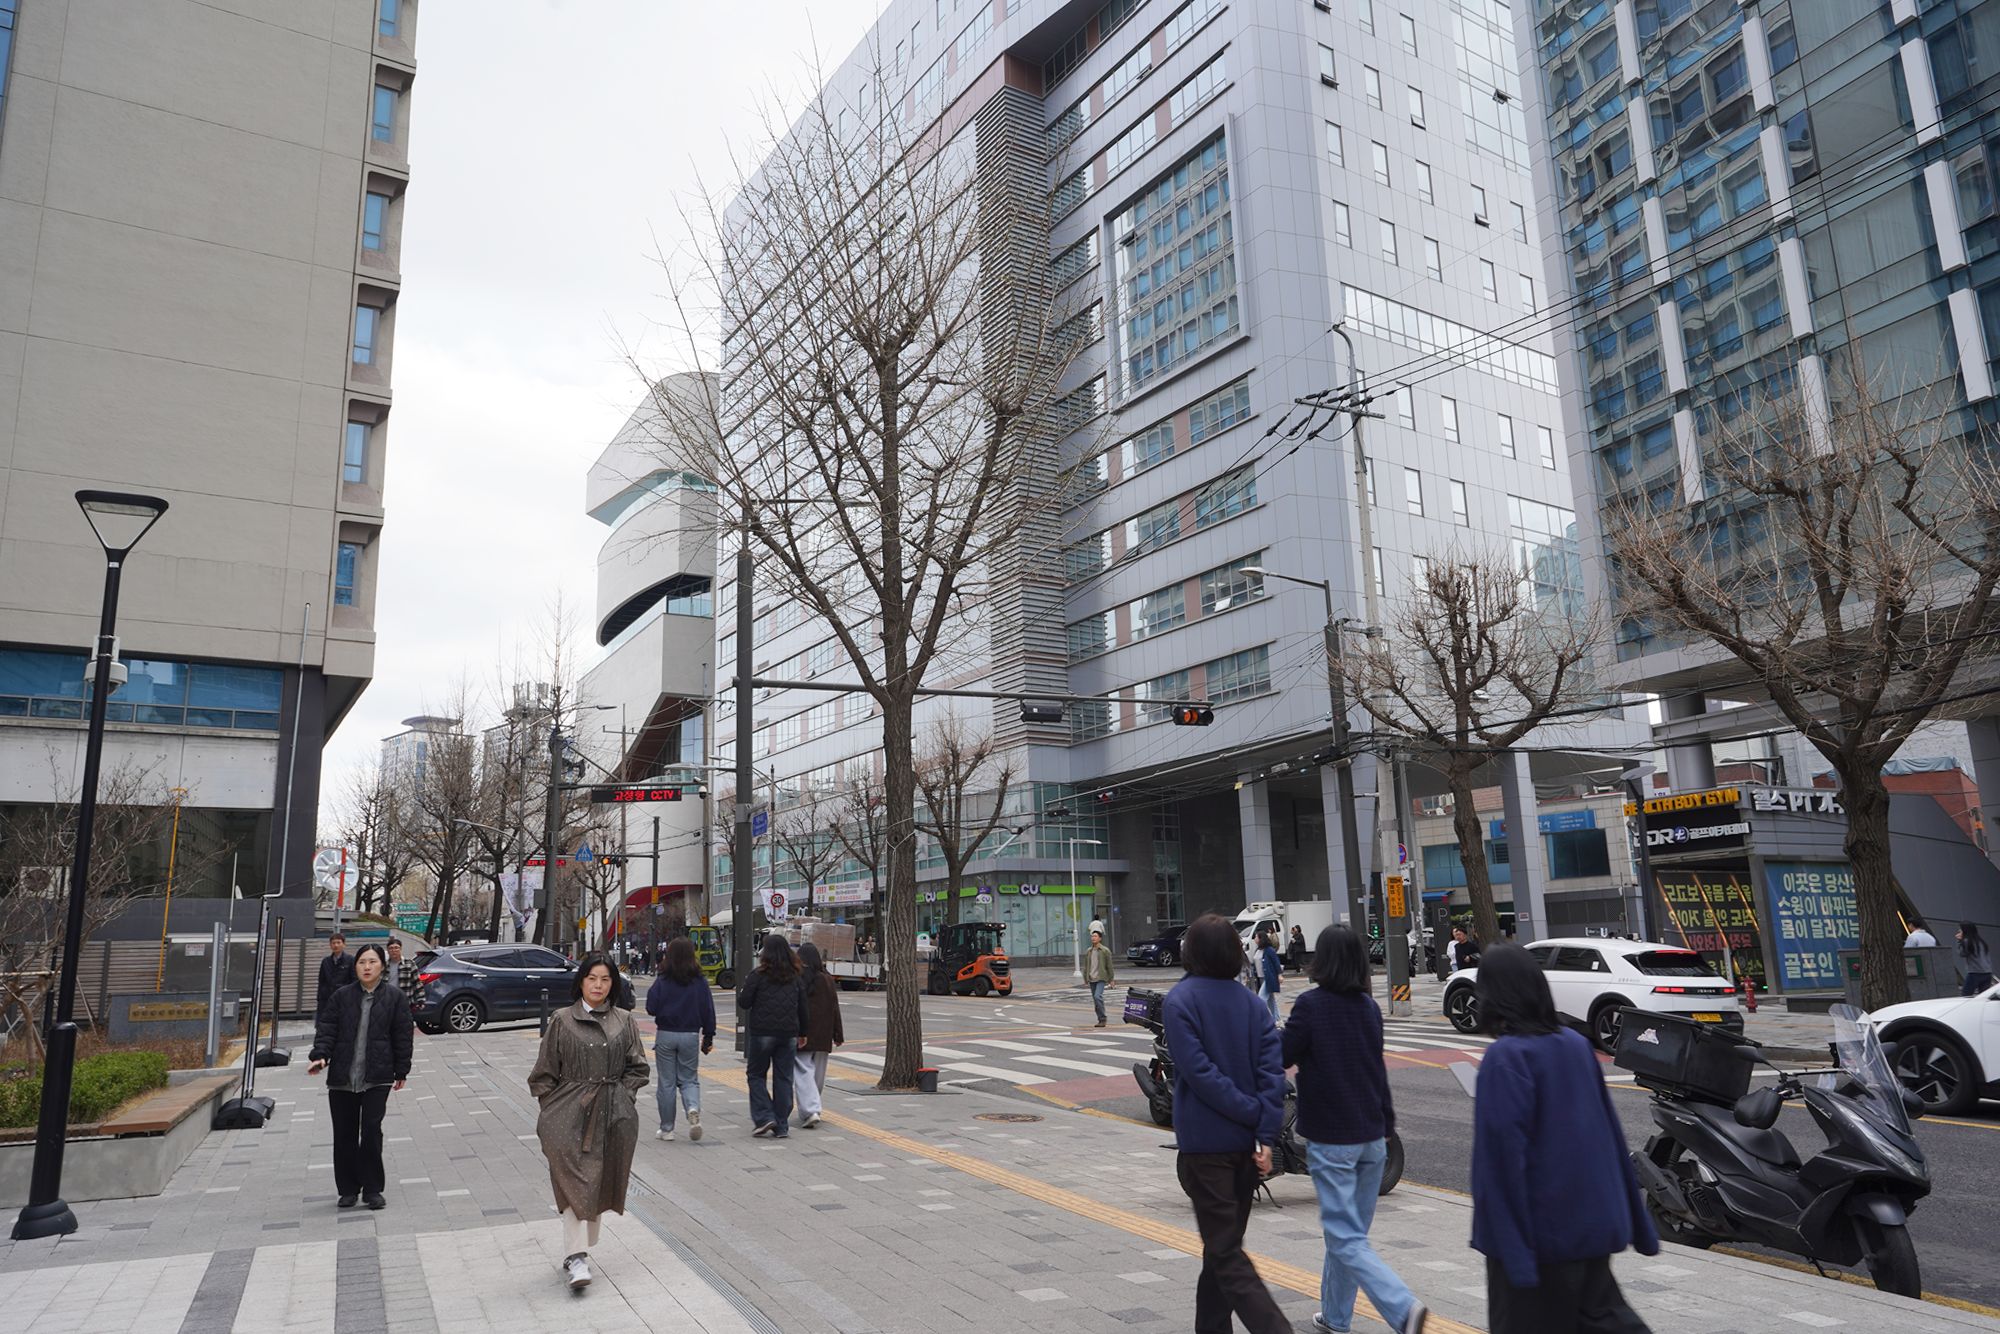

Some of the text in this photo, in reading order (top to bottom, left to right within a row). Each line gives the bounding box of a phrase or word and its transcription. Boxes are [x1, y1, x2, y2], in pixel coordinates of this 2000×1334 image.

[614, 789, 675, 801] 고정형 CCTV
[1705, 787, 1740, 806] GYM
[1752, 788, 1788, 811] 헬스
[1788, 791, 1815, 812] PT
[1020, 884, 1039, 895] CU
[1783, 872, 1822, 893] 이곳은
[925, 891, 936, 902] CU
[1778, 896, 1858, 916] 스윙이 바뀌는
[1780, 919, 1860, 939] 몸이 달라지는
[1783, 952, 1836, 979] 골프인
